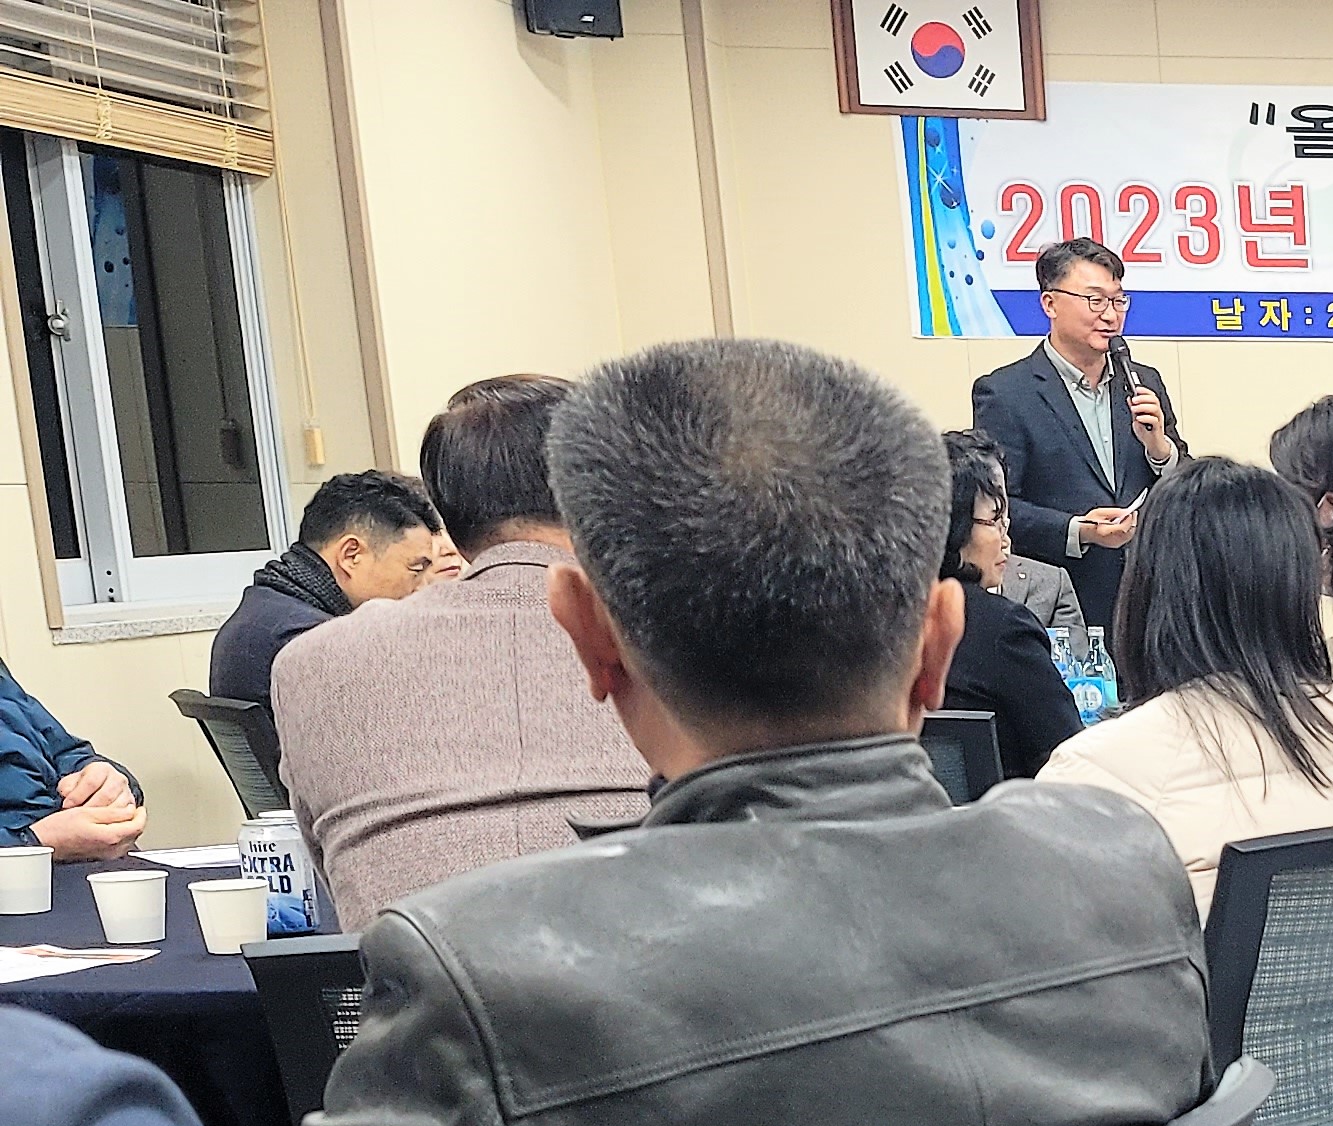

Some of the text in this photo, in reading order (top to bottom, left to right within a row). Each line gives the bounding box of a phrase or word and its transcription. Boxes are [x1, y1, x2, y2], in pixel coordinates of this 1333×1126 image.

[1000, 181, 1310, 271] 2023년
[249, 841, 277, 853] hite
[241, 853, 296, 873] EXTRA
